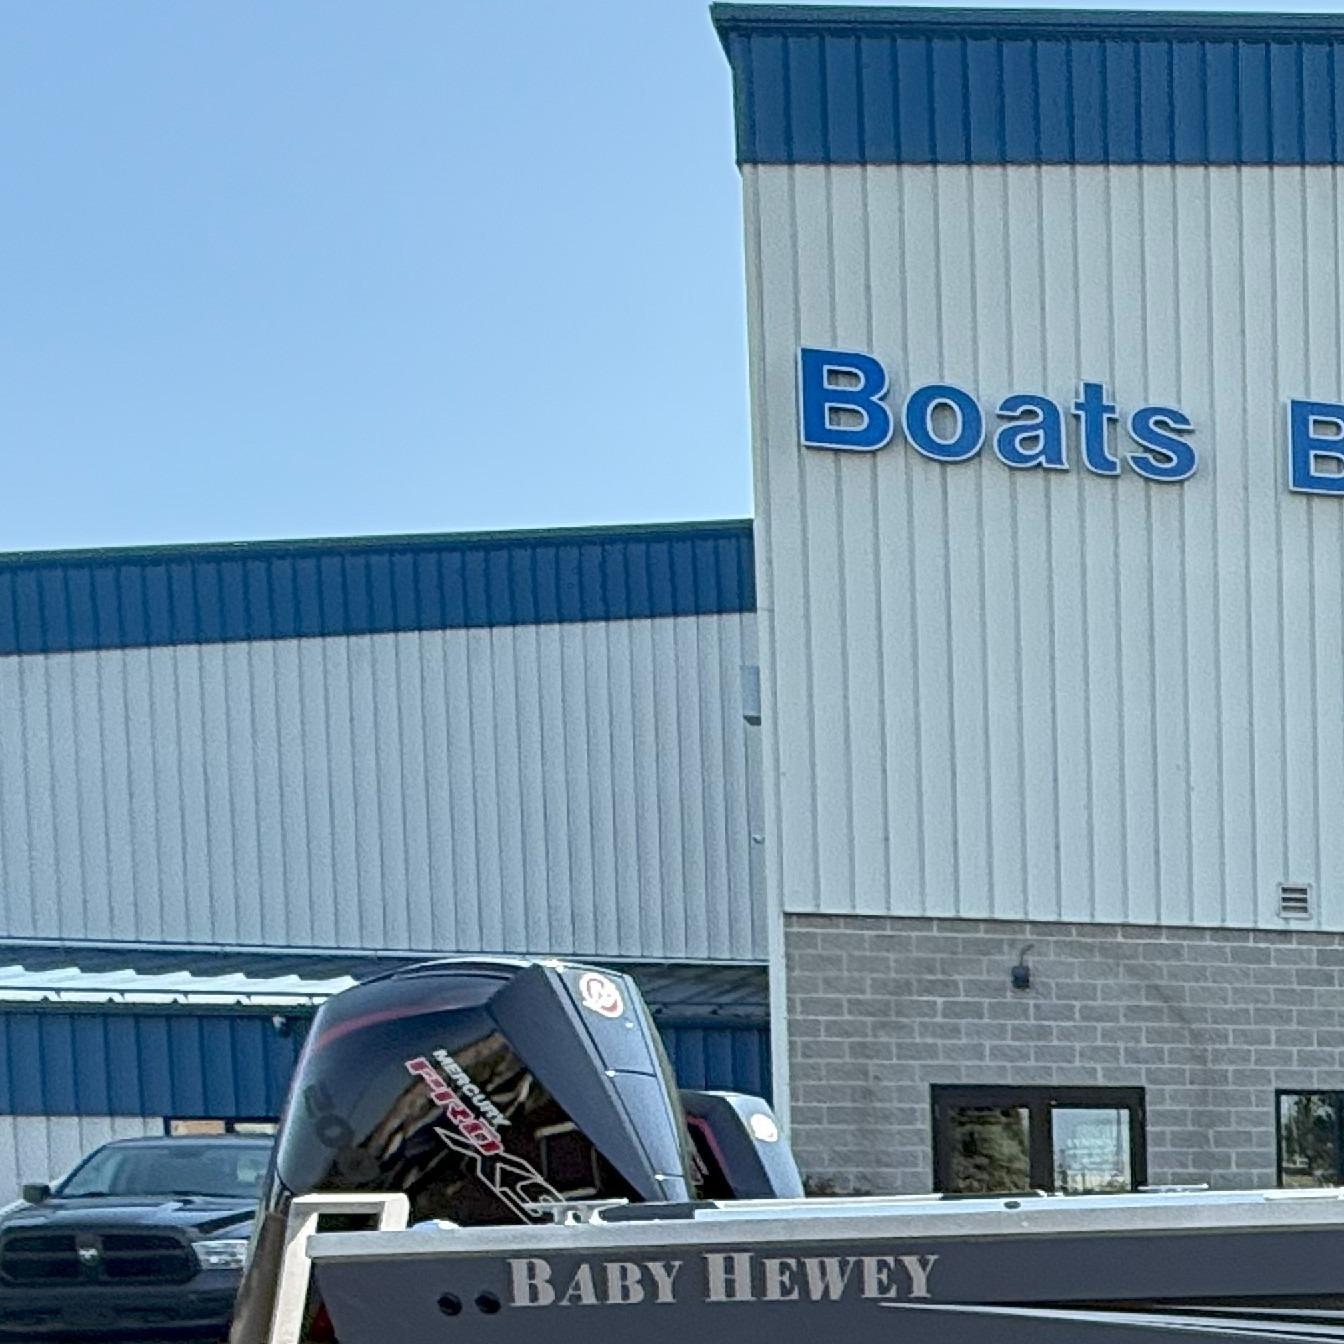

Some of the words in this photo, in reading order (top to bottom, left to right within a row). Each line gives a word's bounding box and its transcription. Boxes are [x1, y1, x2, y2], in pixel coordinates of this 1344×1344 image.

[799, 346, 1199, 482] Boats
[404, 1057, 504, 1155] PRO
[432, 1048, 512, 1126] MERCURY
[506, 1258, 683, 1307] BABY
[703, 1252, 940, 1302] HEWEY
